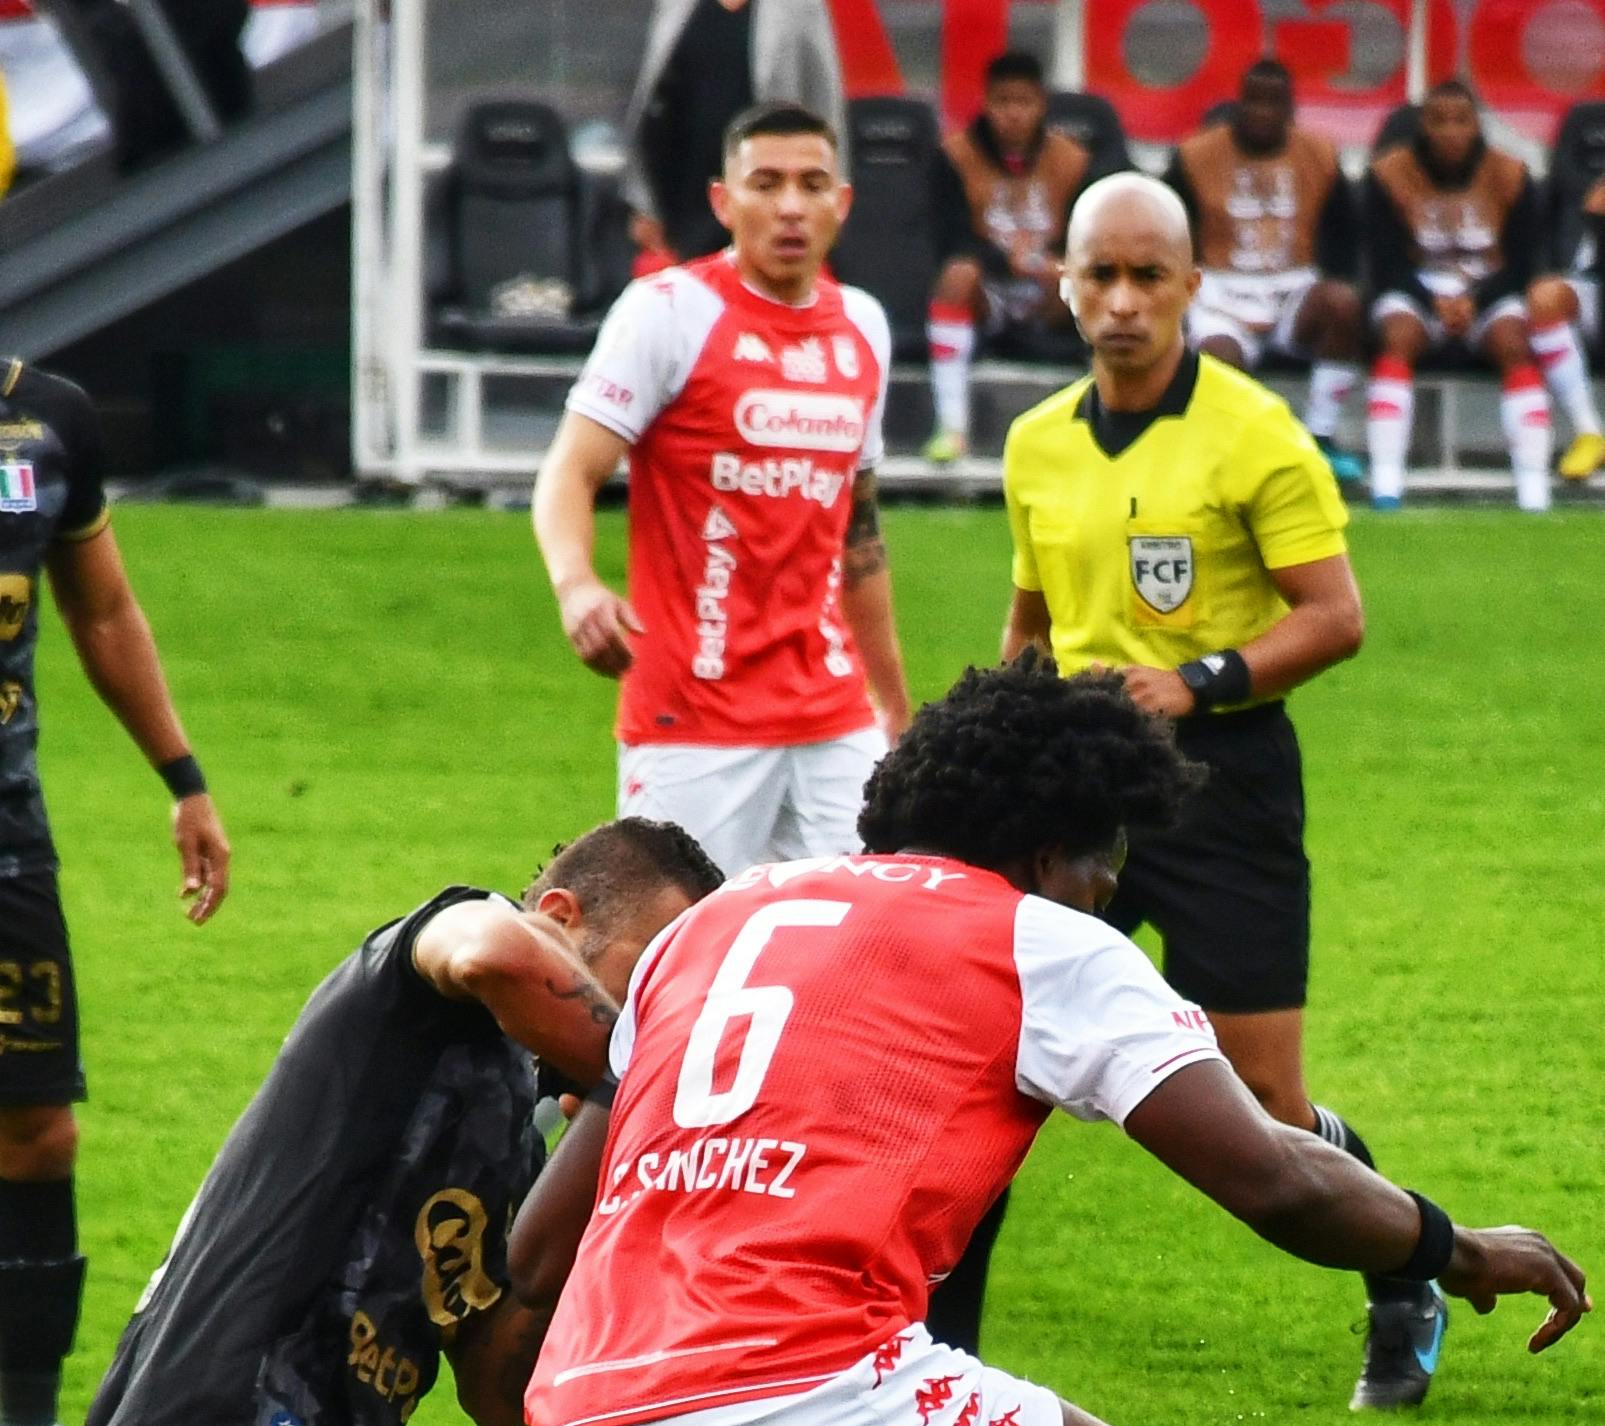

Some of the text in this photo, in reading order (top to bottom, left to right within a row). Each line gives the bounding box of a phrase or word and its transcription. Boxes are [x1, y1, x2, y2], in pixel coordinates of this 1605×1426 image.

[711, 452, 846, 509] BetPlay
[693, 541, 738, 680] BetPlay
[1135, 559, 1188, 584] FCF
[673, 898, 852, 1130] 6
